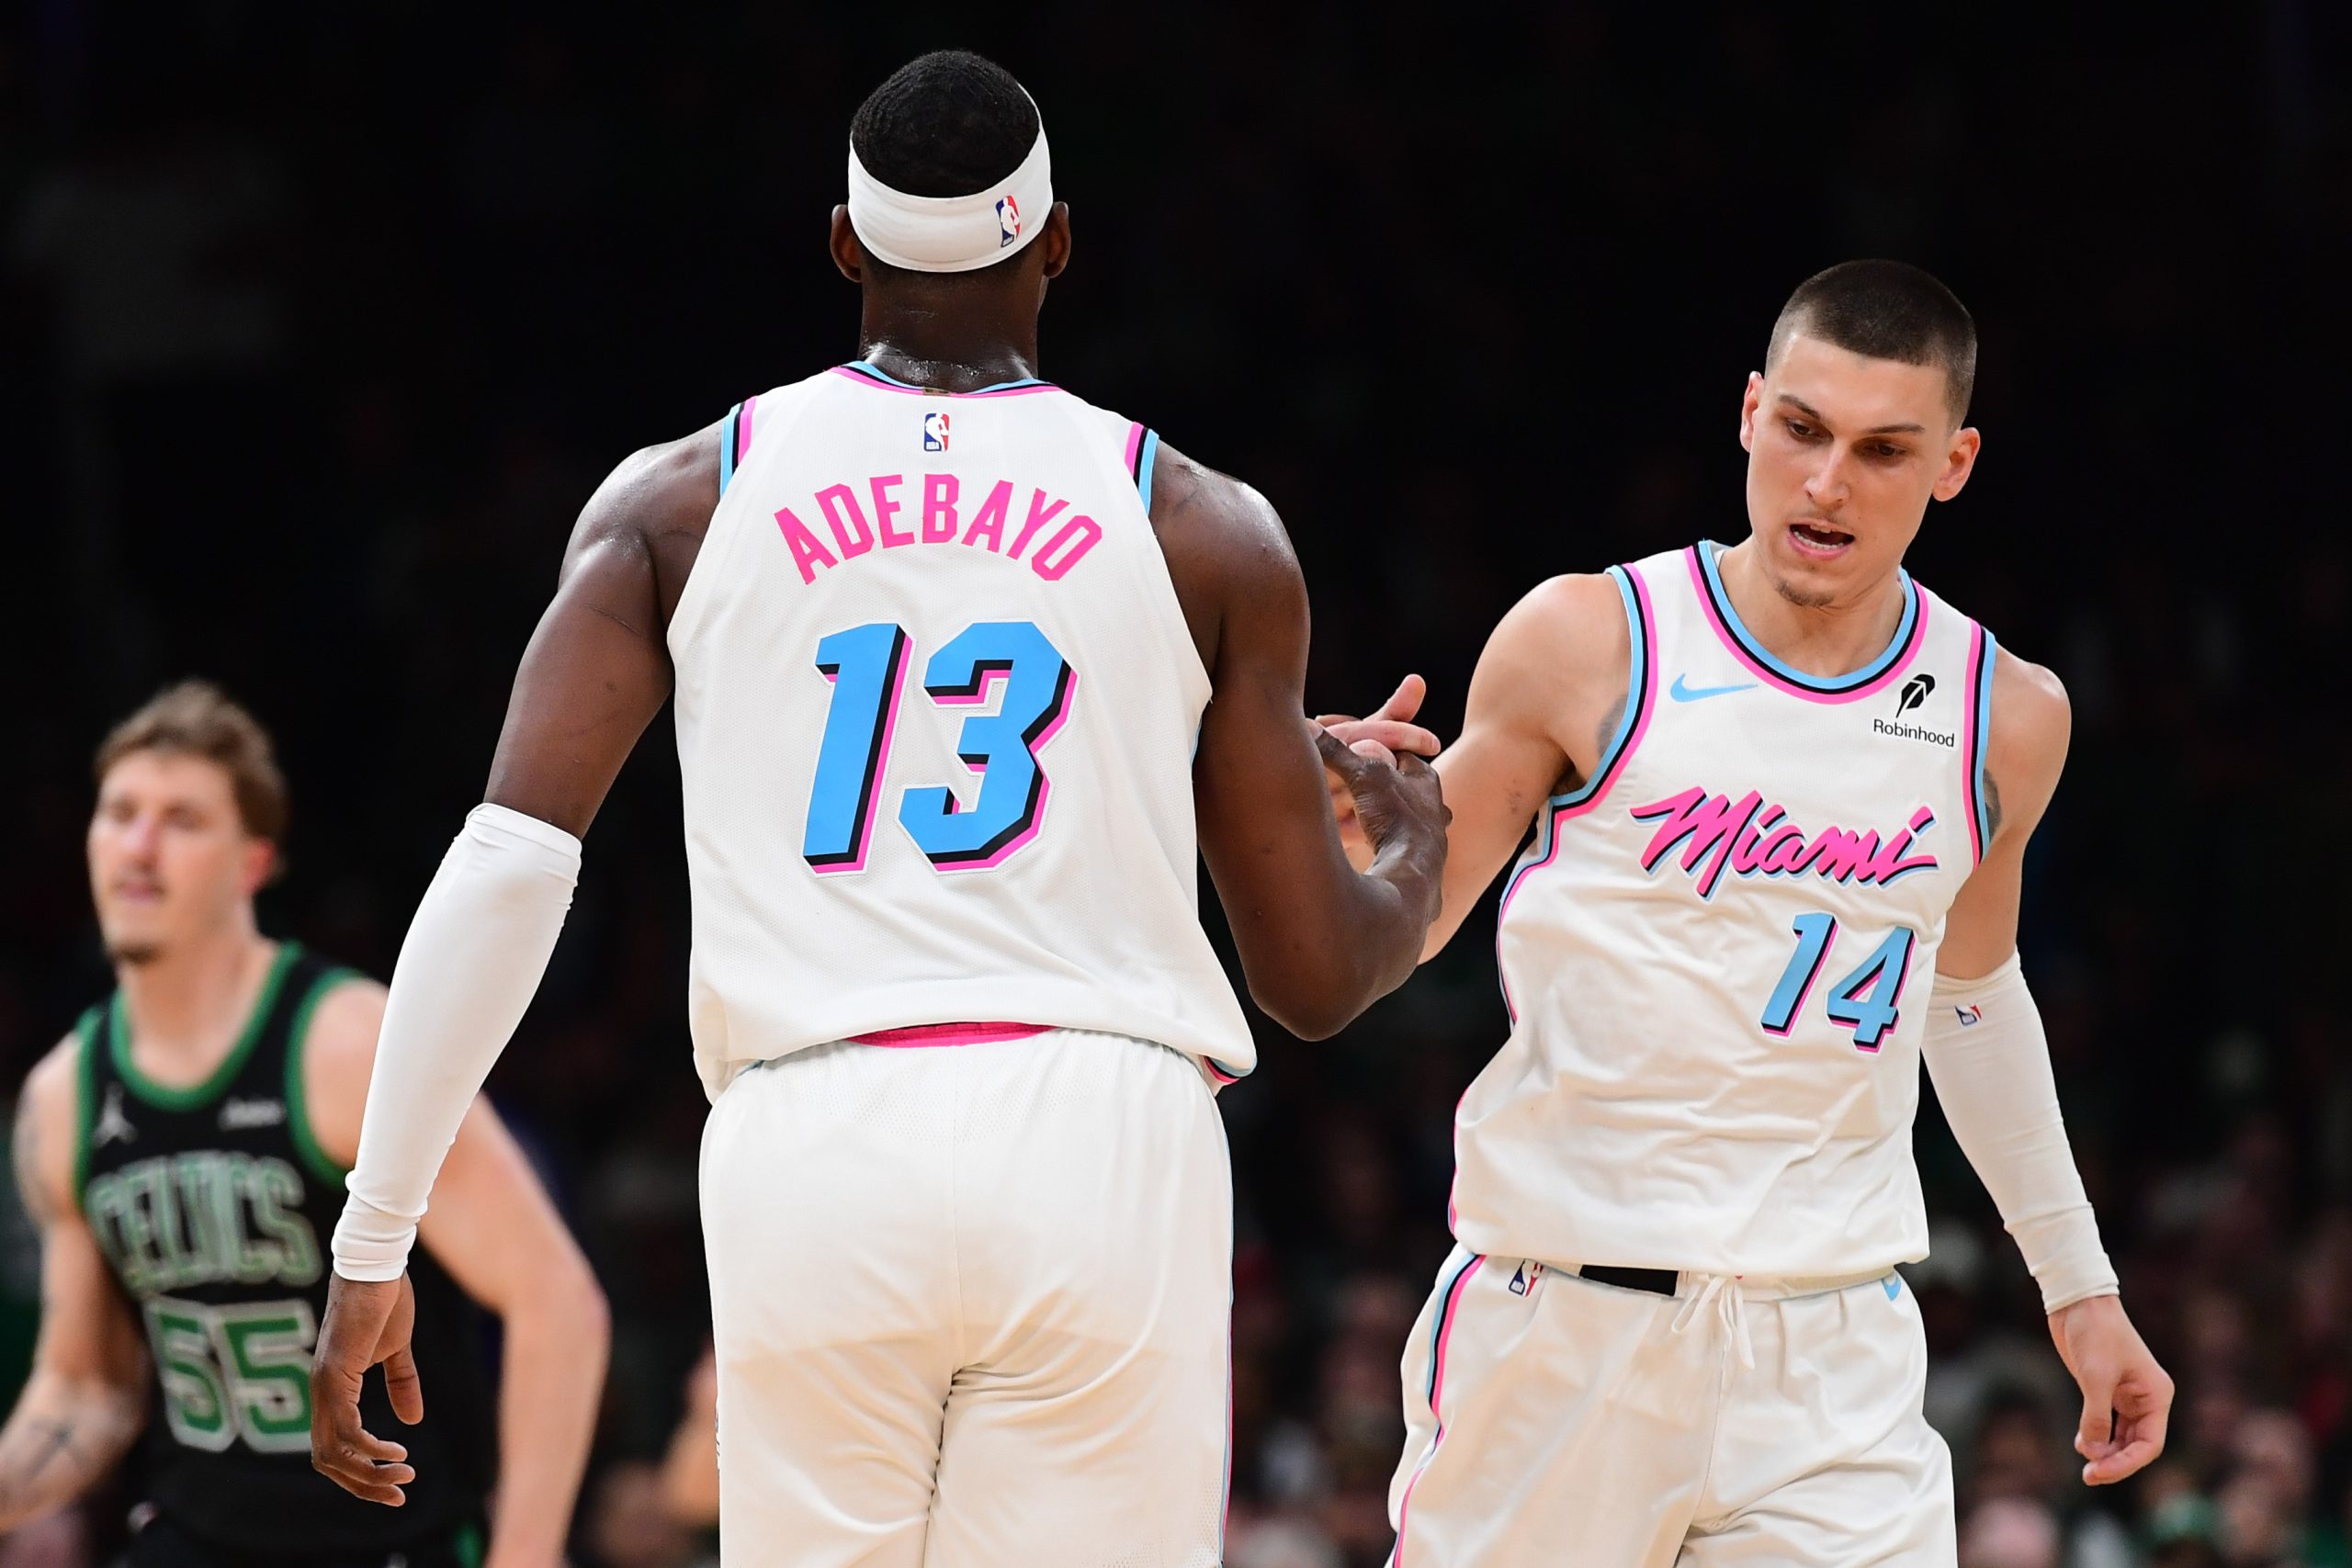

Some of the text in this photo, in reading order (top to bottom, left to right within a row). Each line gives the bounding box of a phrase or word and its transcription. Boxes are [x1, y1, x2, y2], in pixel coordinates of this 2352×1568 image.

[774, 474, 1102, 585] ADEBAYO
[802, 621, 1079, 874] 13
[1873, 718, 1954, 747] Robinhood
[1630, 785, 1939, 902] Miami
[1760, 912, 1915, 1054] 14
[87, 1151, 322, 1293] CELTICS
[144, 1298, 316, 1454] 55
